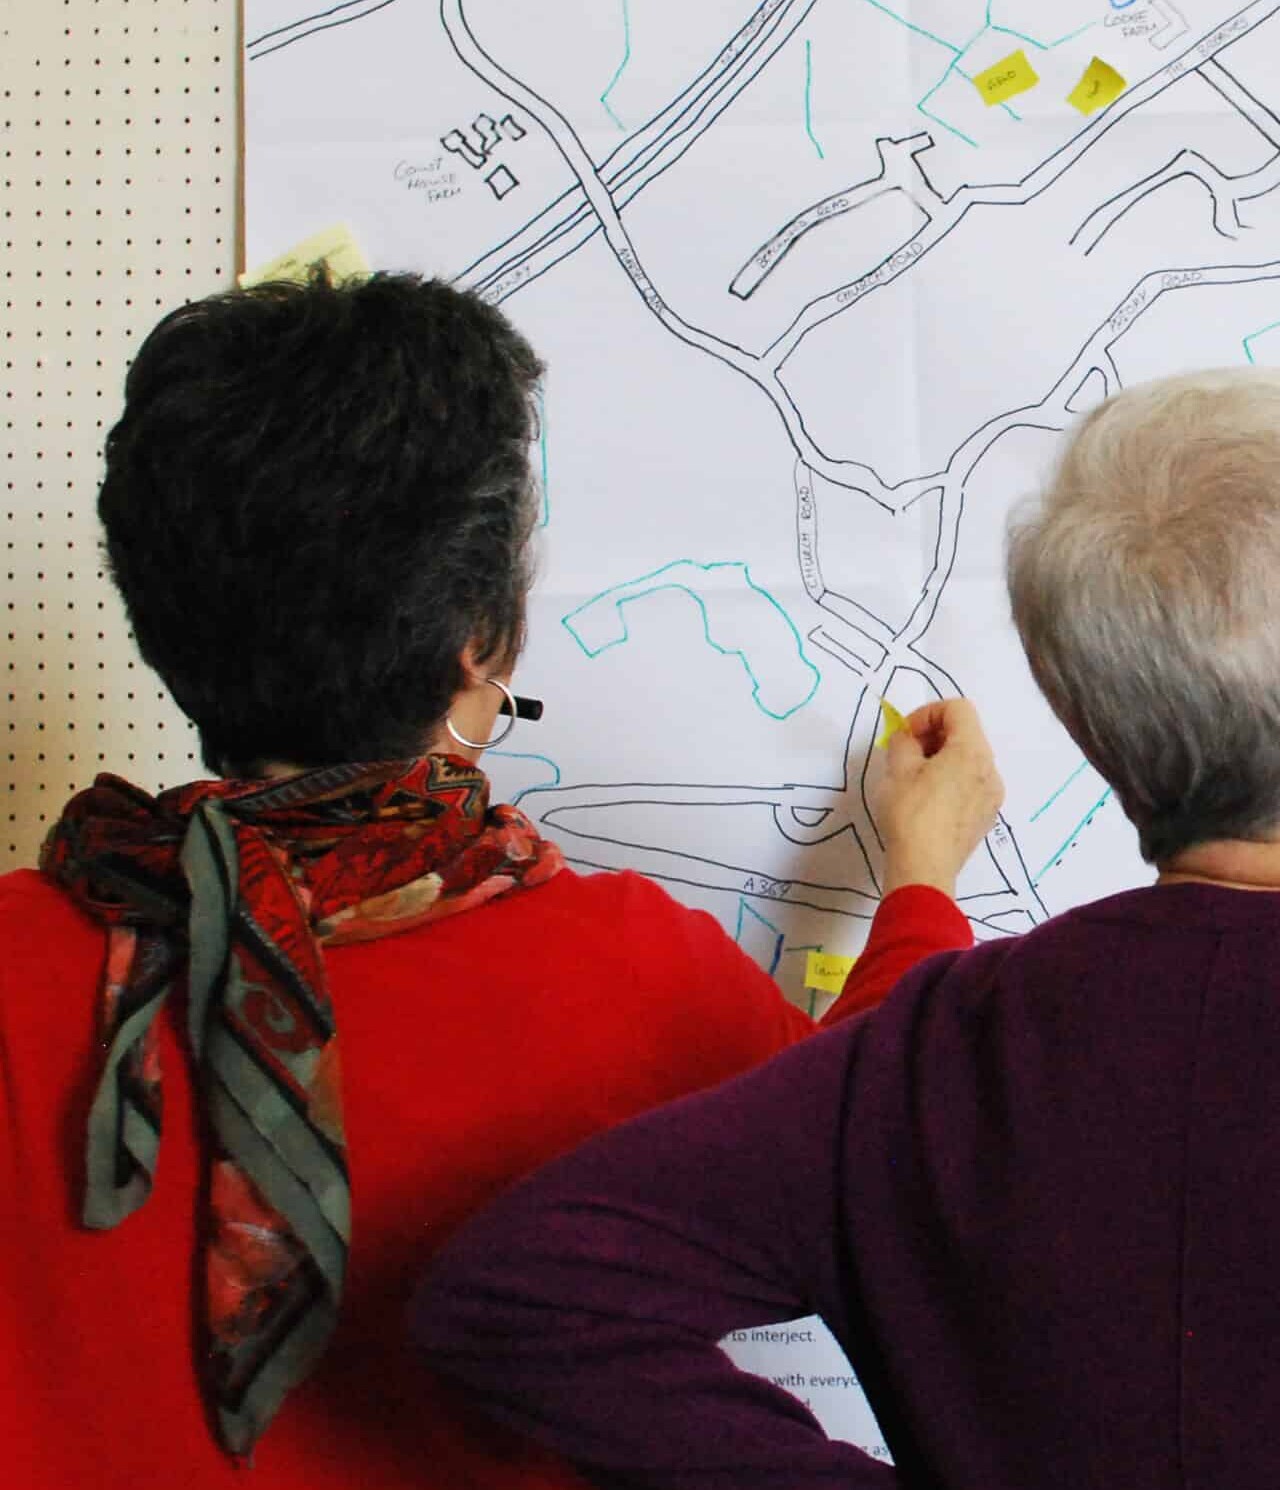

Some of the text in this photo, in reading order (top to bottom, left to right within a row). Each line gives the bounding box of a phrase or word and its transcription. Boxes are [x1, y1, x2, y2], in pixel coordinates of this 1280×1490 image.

[887, 241, 924, 272] ROAD
[800, 485, 818, 589] CHURCH ROAD
[732, 1329, 817, 1346] to interject.
[772, 1373, 806, 1387] with
